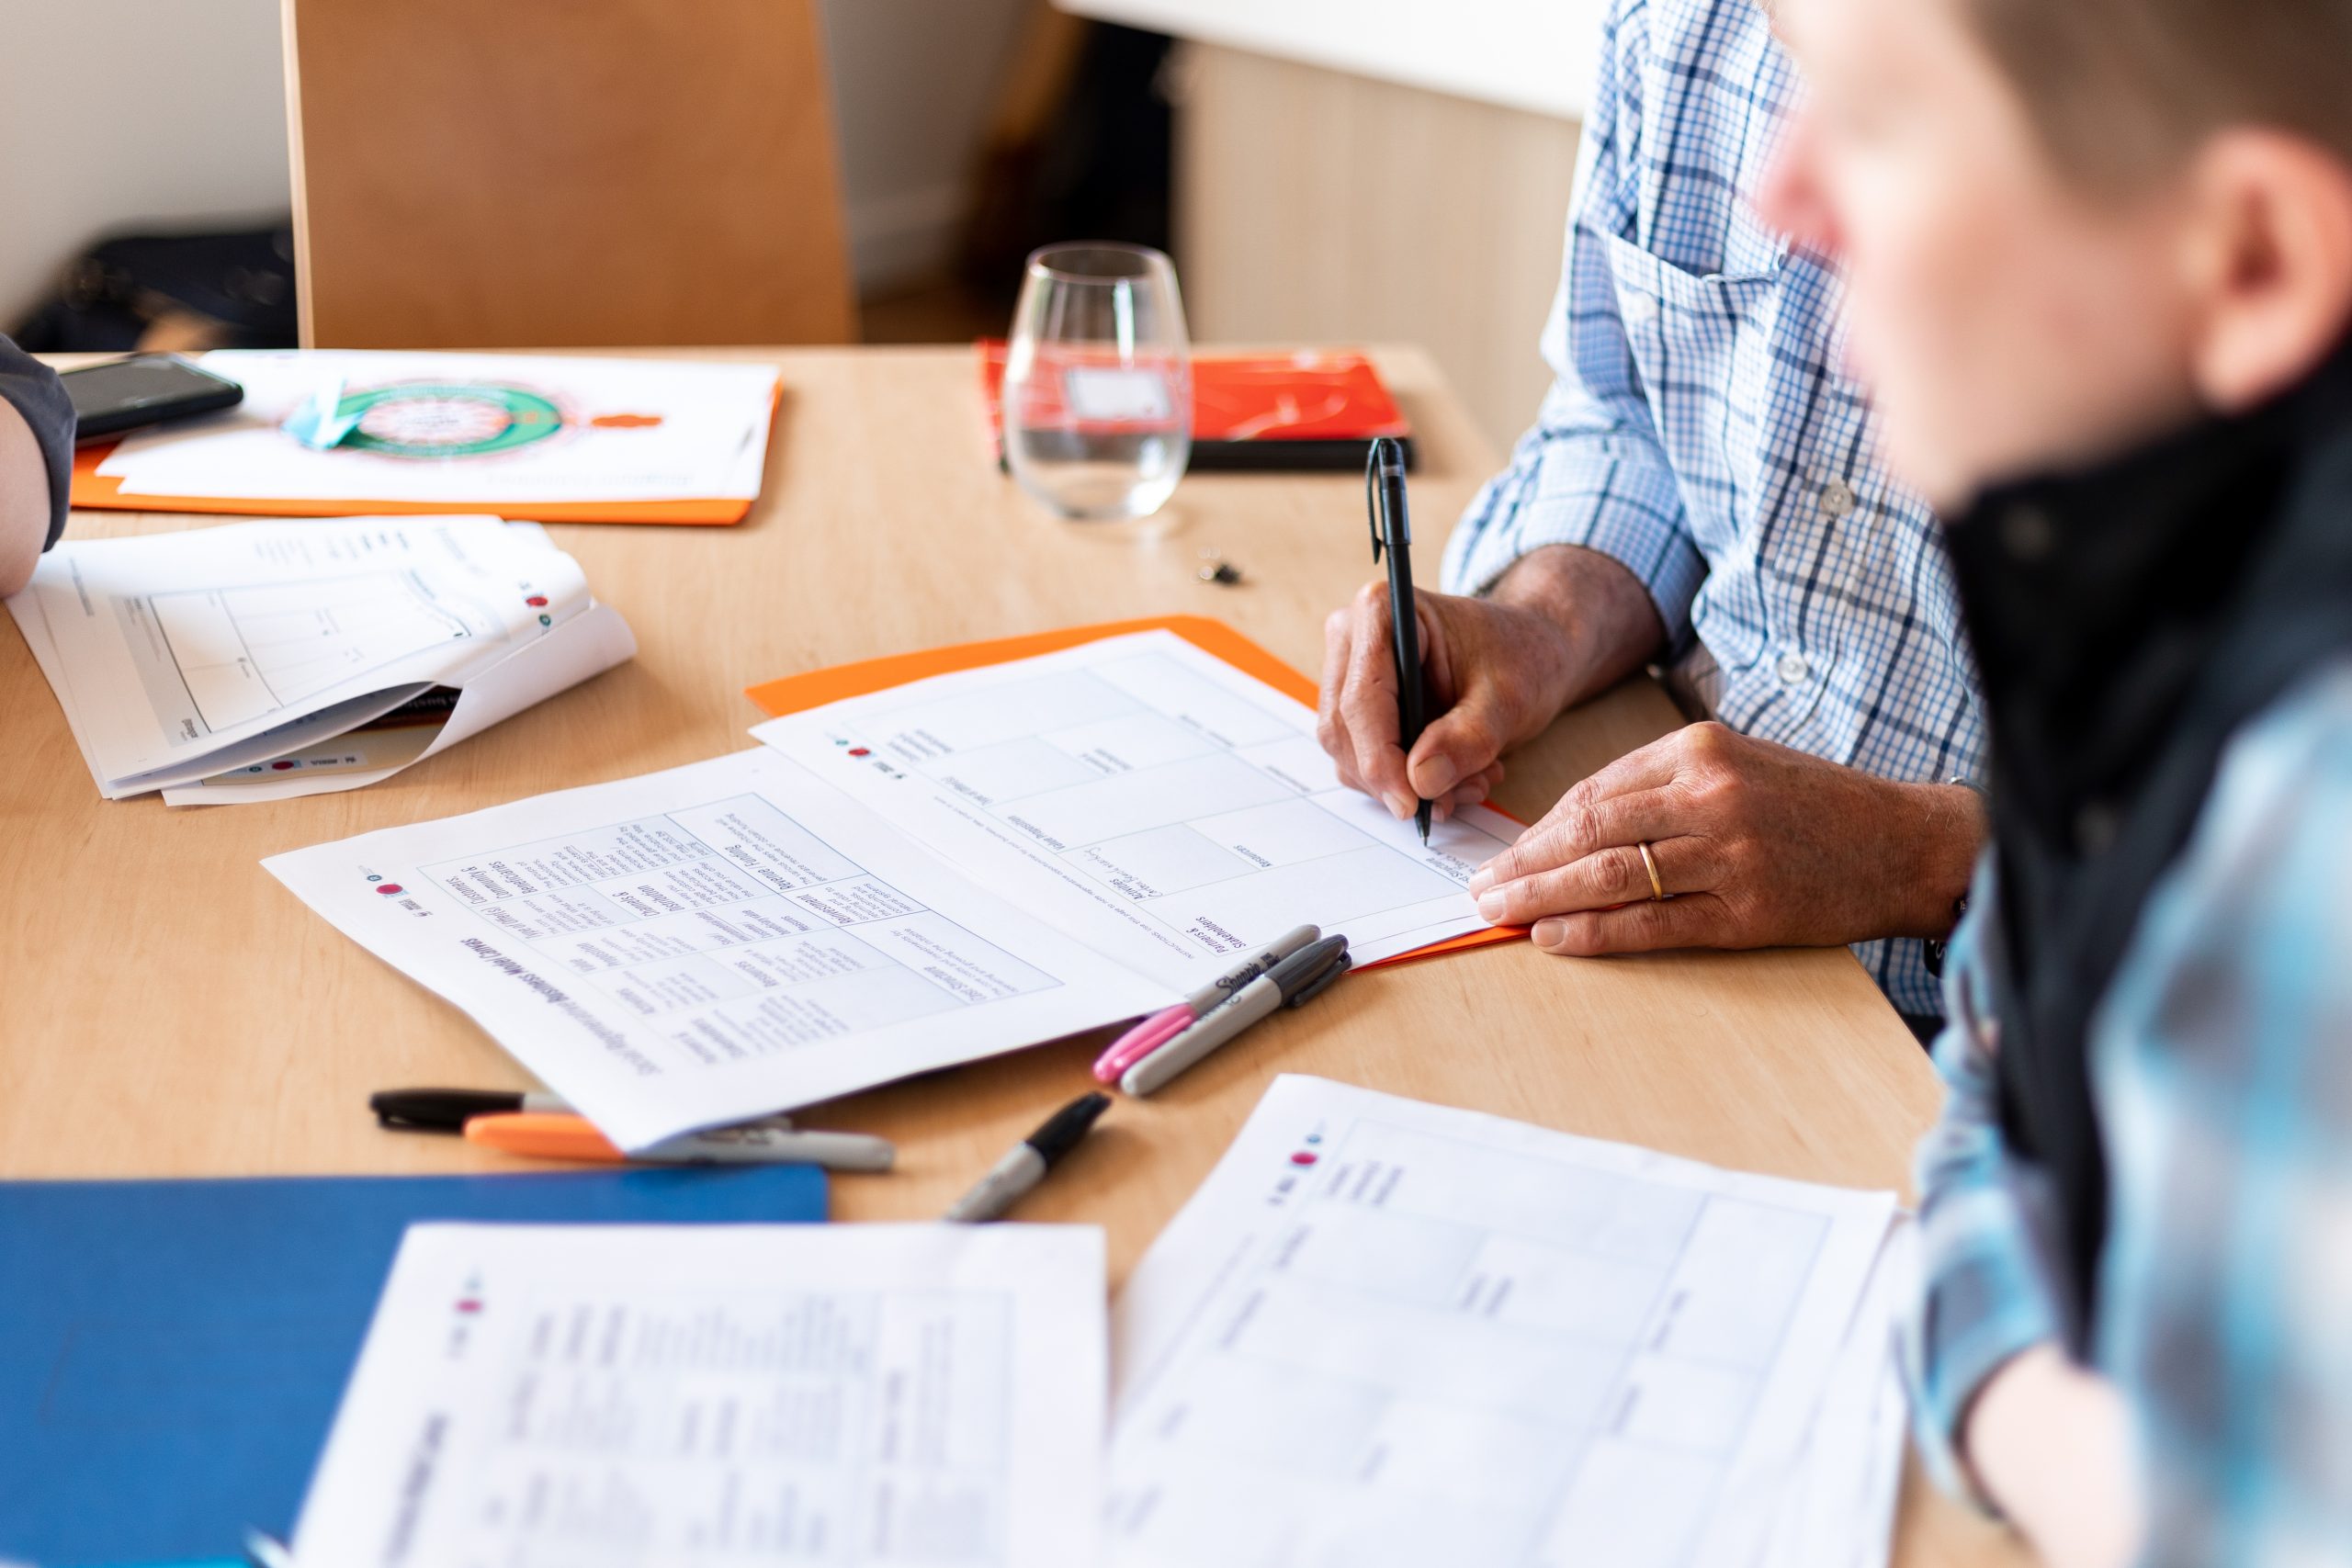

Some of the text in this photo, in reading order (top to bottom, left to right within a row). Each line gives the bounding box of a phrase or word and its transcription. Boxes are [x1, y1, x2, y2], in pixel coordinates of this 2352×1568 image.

[1007, 816, 1066, 851] Value Proposition
[724, 843, 761, 867] Funding
[1233, 845, 1273, 867] Resources
[1426, 856, 1463, 878] Structure
[445, 876, 489, 904] Customers,
[469, 871, 514, 898] Community
[487, 862, 538, 895] Beneficiaries
[757, 867, 796, 891] Revenue
[1110, 878, 1147, 900] Activities
[619, 895, 662, 917] Channels
[636, 886, 685, 911] Distribution
[796, 893, 856, 924] Reinvestment
[864, 893, 904, 913] community
[516, 928, 544, 939] Type
[781, 915, 812, 931] Measures
[1196, 917, 1248, 948] Stakeholders
[1194, 931, 1229, 953] Partners
[575, 942, 623, 968] Proposition
[459, 939, 570, 1003] Business Model Canvas
[733, 961, 779, 988] Resources
